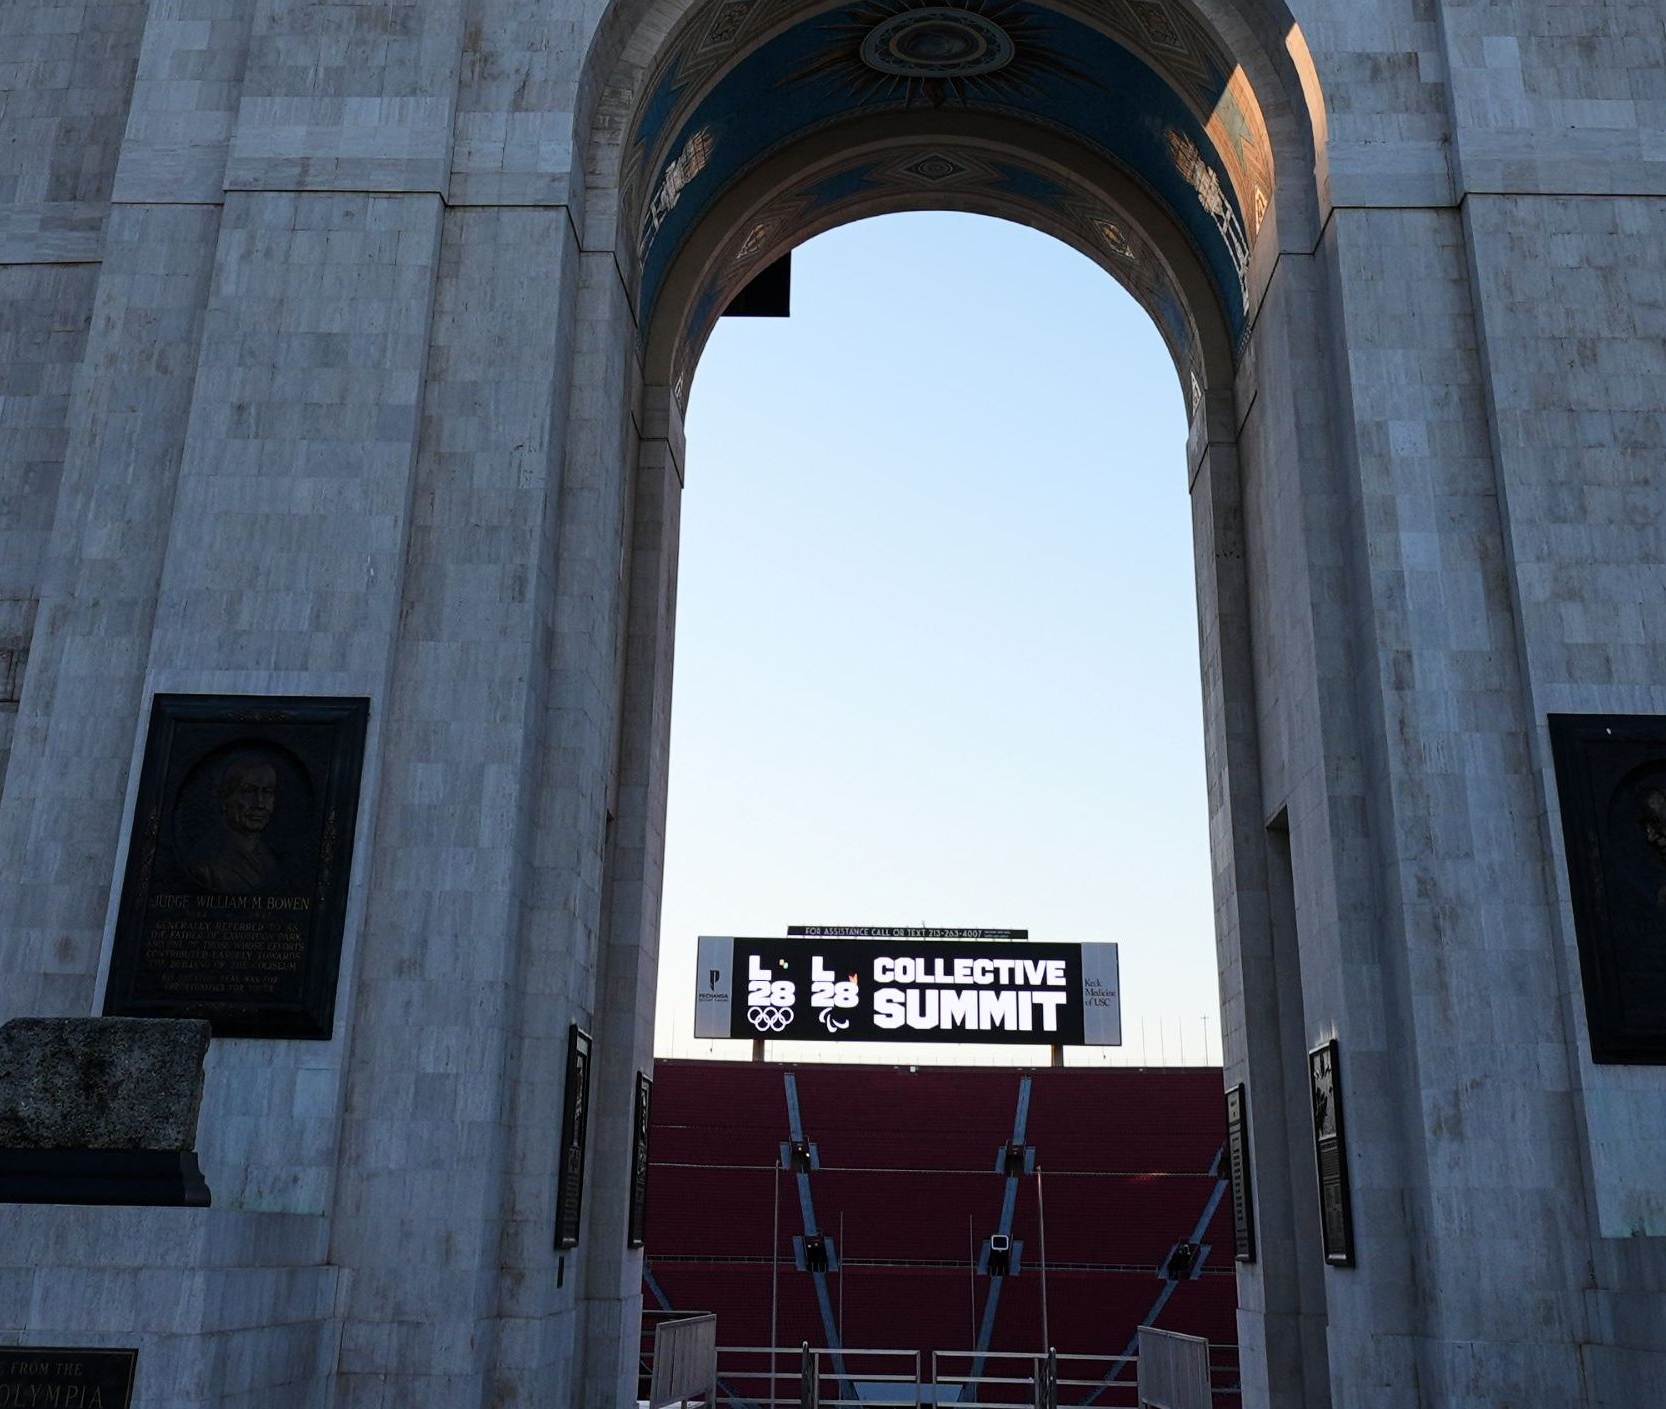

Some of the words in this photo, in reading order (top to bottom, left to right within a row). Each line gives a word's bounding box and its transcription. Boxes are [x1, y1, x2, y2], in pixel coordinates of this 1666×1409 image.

[151, 894, 191, 909] JUDGE
[197, 895, 247, 909] WILLIAM
[266, 896, 310, 911] BOWEN
[805, 927, 821, 936] FOR
[823, 927, 869, 937] ASSISTANCE
[871, 928, 890, 937] CALL
[892, 928, 905, 937] OR
[907, 928, 926, 938] TEXT
[873, 956, 1067, 986] COLLECTIVE
[748, 980, 796, 1007] 28
[810, 981, 859, 1008] 28
[873, 989, 1067, 1032] SUMMIT
[11, 1361, 49, 1375] FROM
[55, 1362, 84, 1376] THE
